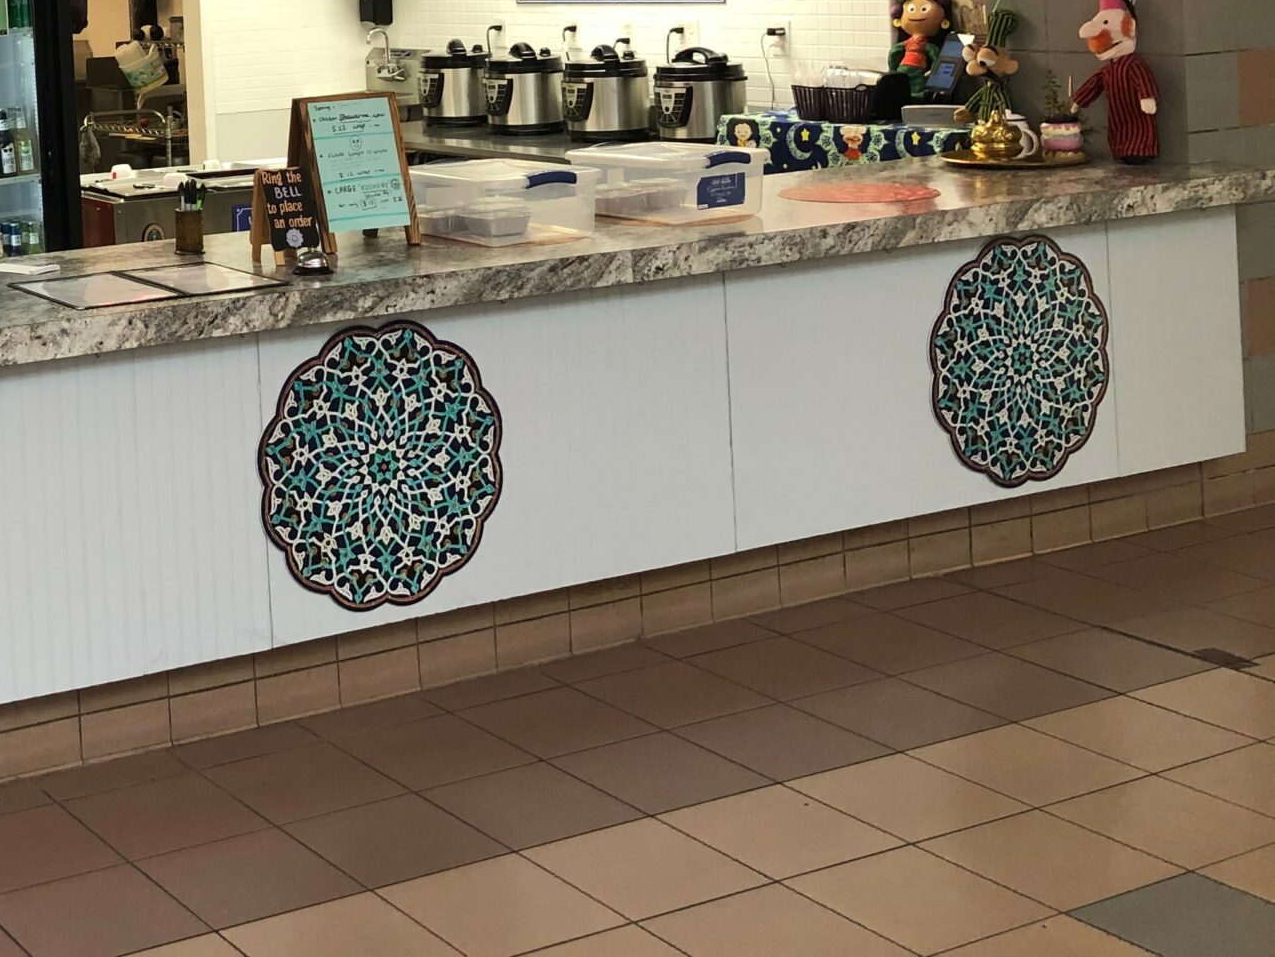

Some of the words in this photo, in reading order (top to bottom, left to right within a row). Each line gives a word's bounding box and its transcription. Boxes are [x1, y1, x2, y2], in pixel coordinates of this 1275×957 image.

[261, 171, 283, 186] Ring
[286, 170, 302, 183] the
[274, 186, 303, 199] BELL
[334, 184, 357, 195] LARGE
[266, 202, 278, 215] to
[279, 199, 304, 216] place
[274, 218, 286, 229] an
[288, 214, 313, 228] order
